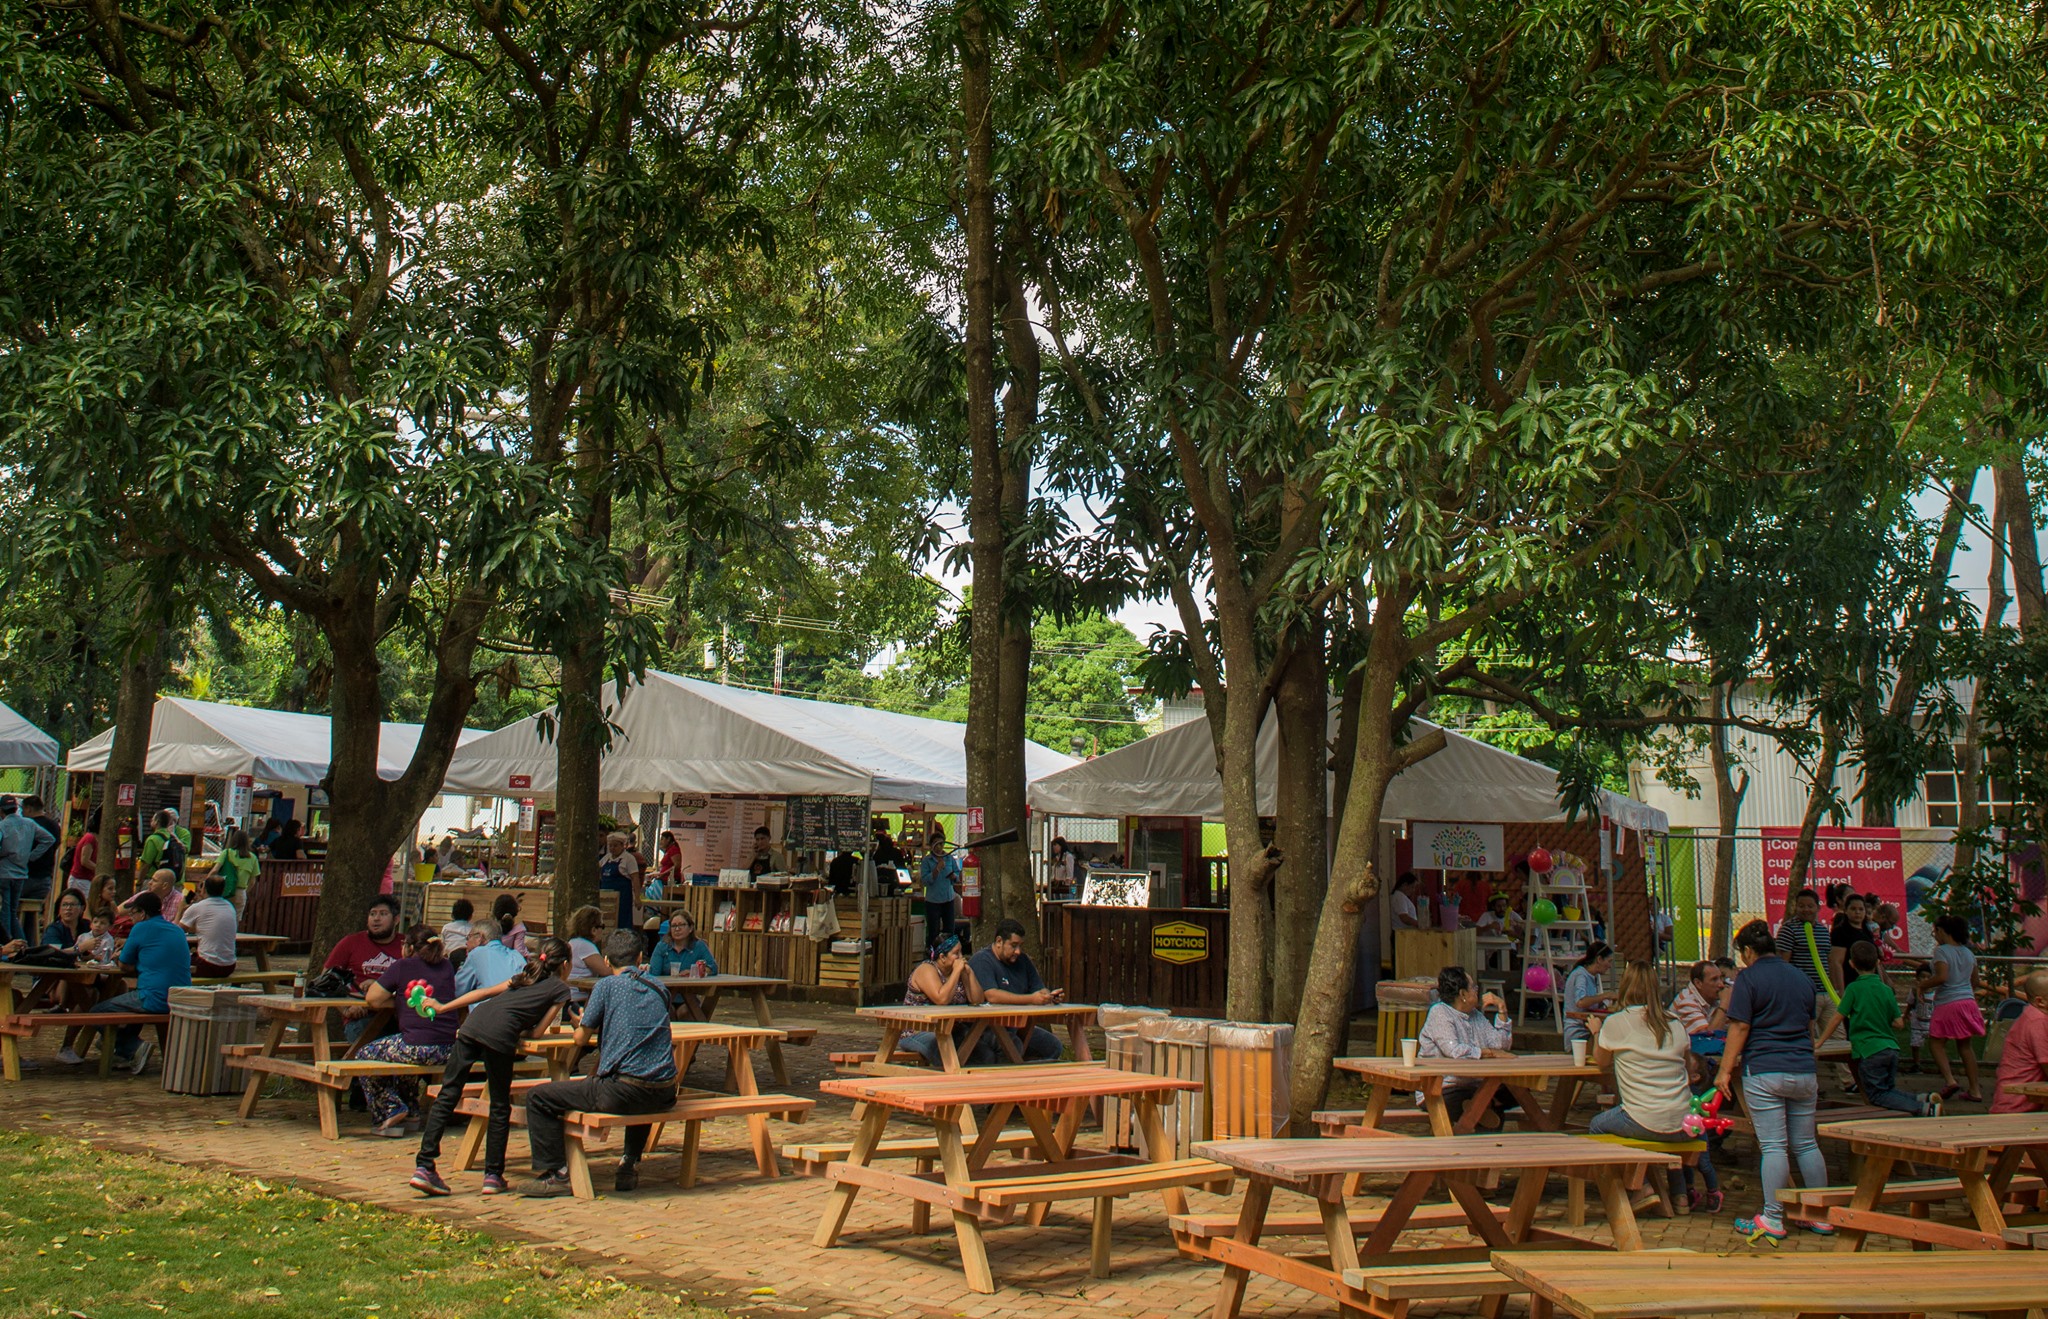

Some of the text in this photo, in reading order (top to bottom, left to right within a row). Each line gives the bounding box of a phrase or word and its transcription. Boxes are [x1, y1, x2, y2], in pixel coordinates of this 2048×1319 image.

[1767, 839, 1825, 851] ¡Cora
[1828, 841, 1845, 850] en
[1433, 851, 1486, 868] kidZone
[1767, 857, 1897, 871] cupes con súper
[1768, 874, 1852, 886] desuentos!
[1155, 937, 1205, 948] HOTCHOS
